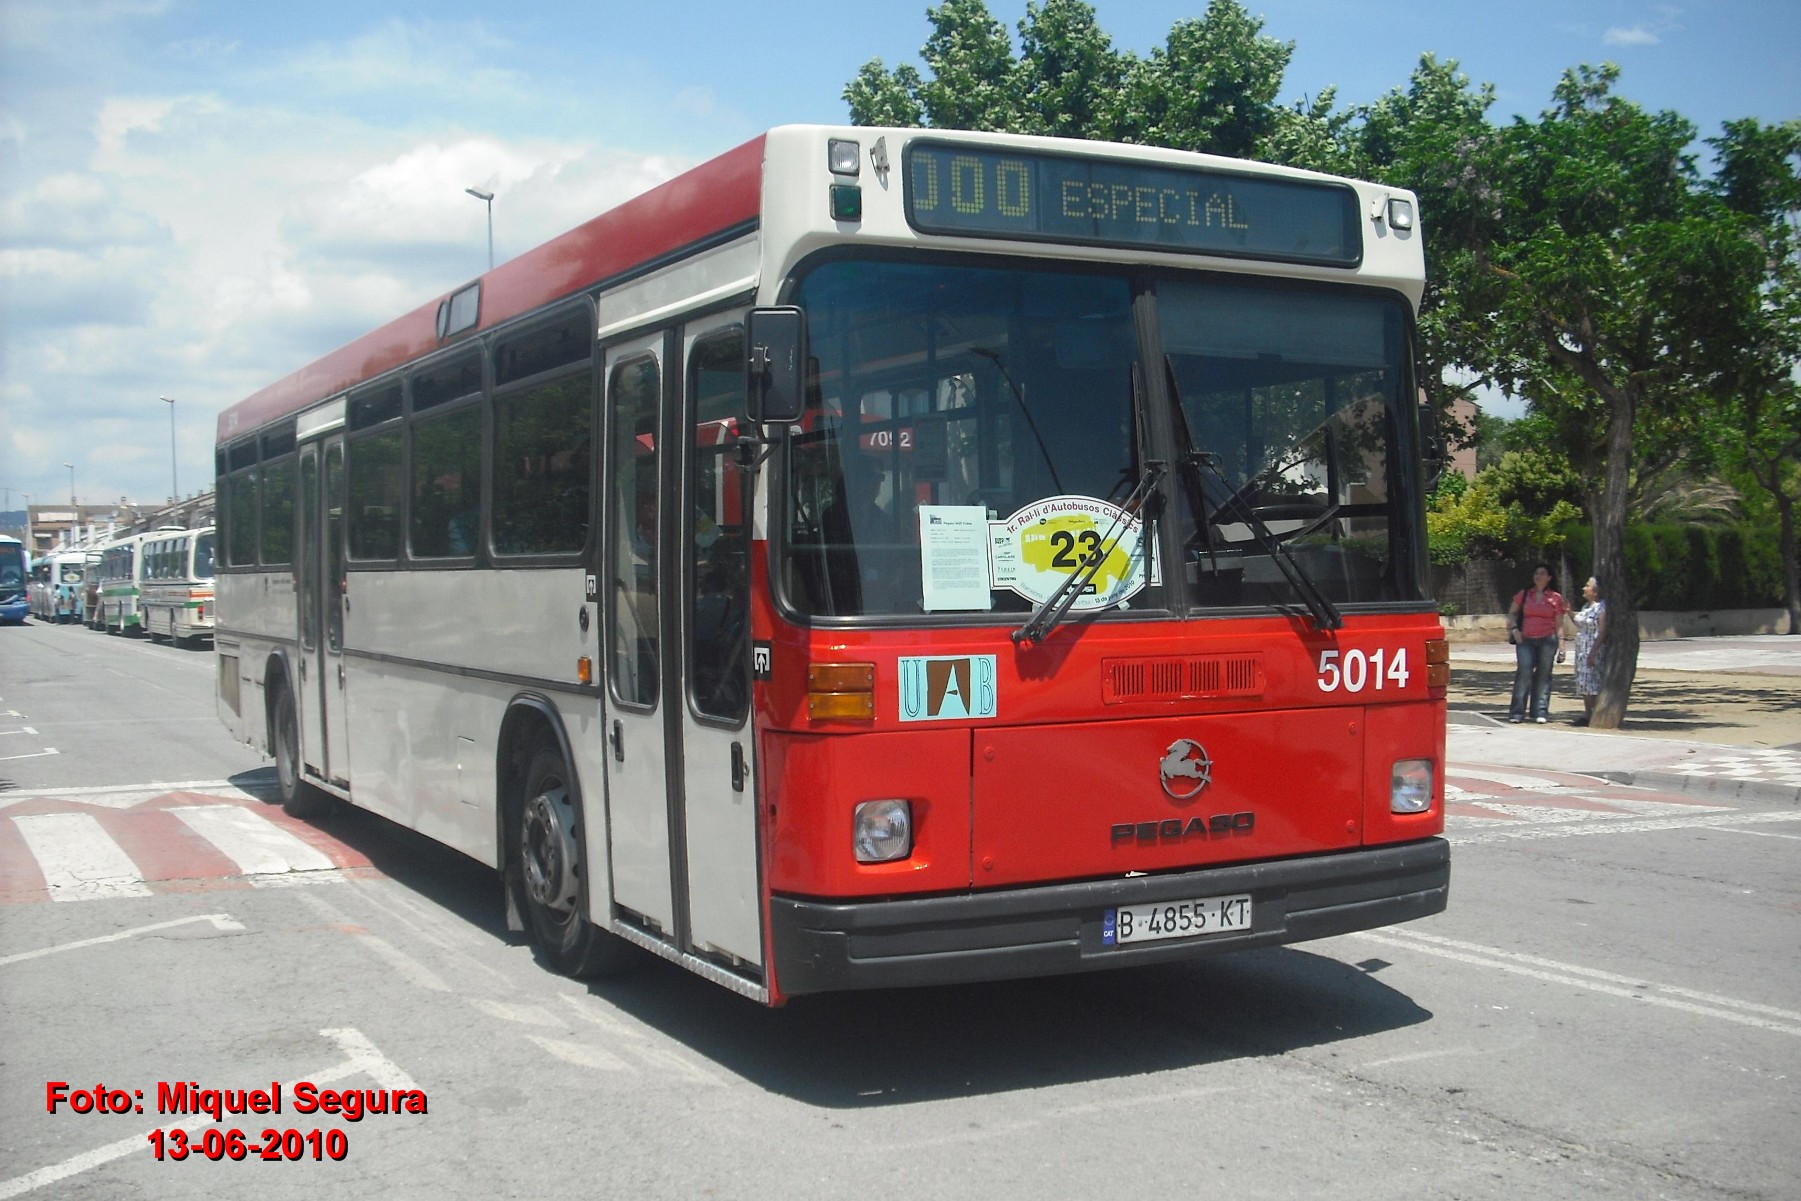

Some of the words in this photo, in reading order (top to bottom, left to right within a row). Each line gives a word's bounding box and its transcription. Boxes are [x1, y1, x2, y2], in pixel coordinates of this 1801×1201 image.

[1062, 180, 1249, 229] ESPECIAL
[1043, 501, 1100, 514] d'Autobusos
[1050, 530, 1104, 567] 23
[900, 657, 994, 718] UAB
[1317, 648, 1409, 692] 5014
[1110, 811, 1255, 843] PEGASO
